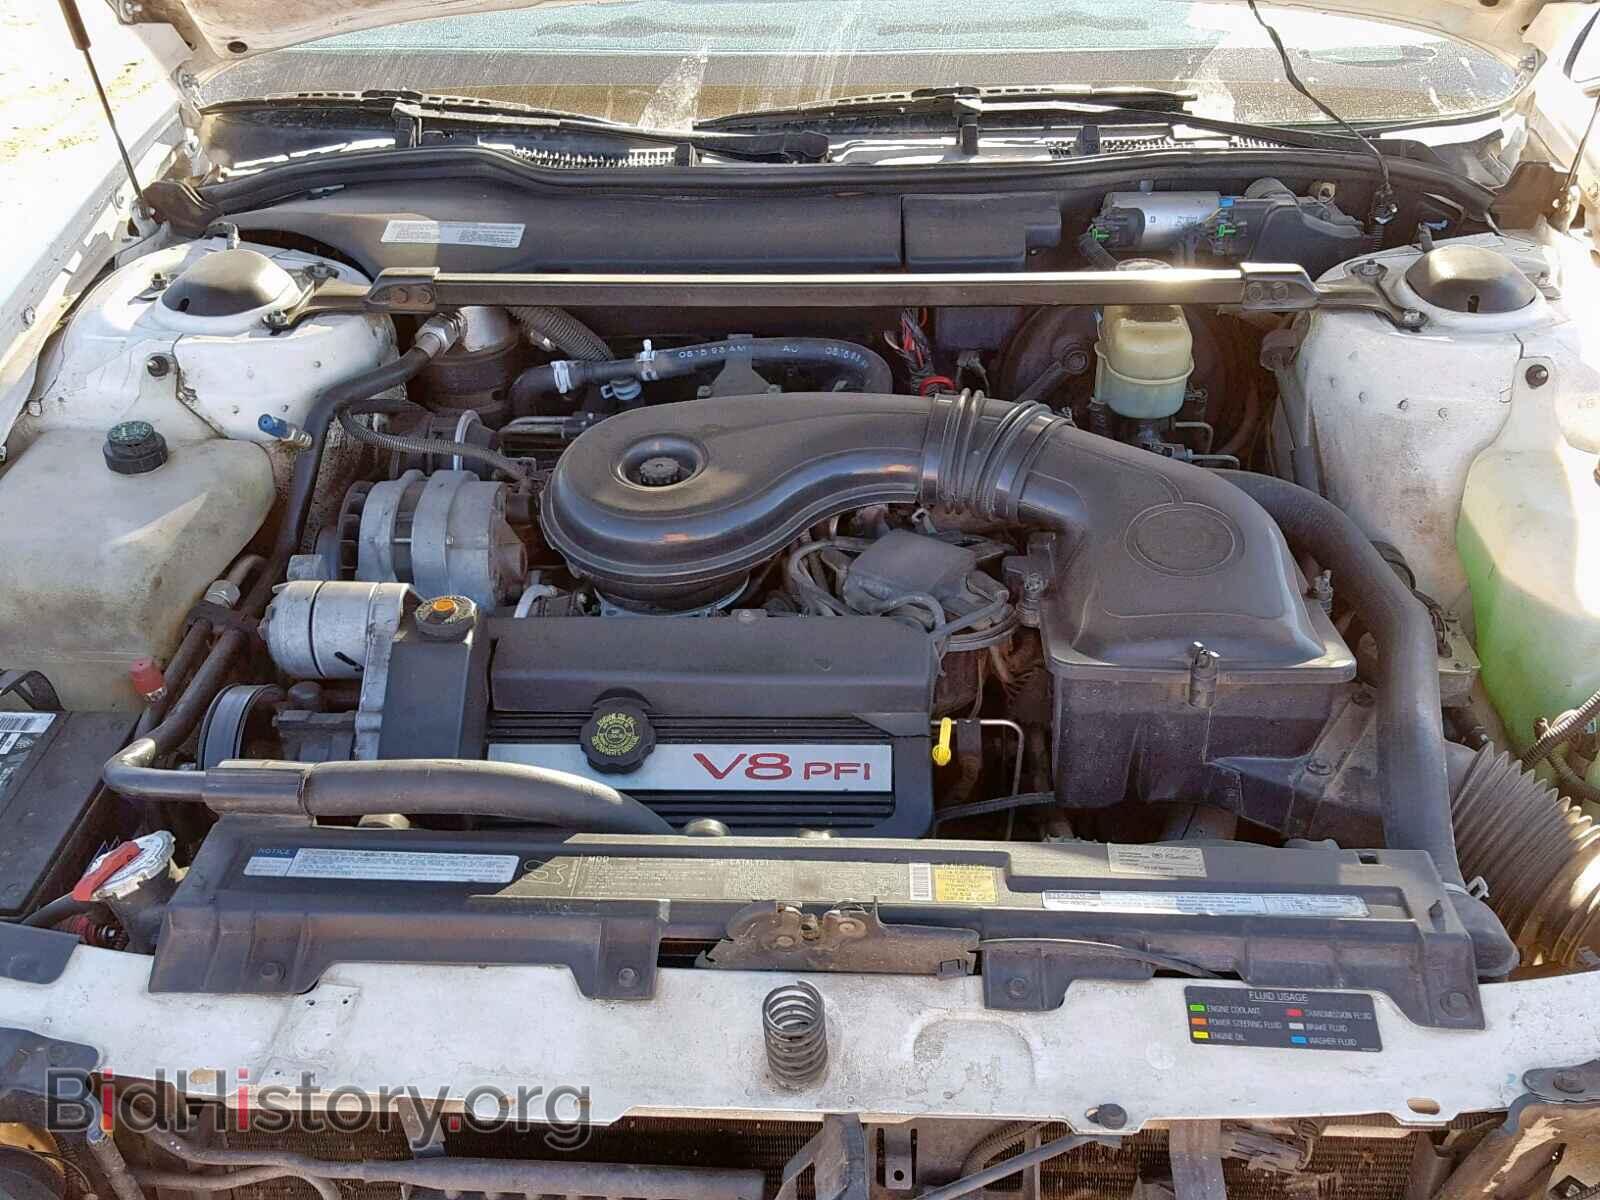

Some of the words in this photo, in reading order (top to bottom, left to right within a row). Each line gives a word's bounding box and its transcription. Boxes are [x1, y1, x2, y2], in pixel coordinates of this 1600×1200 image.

[692, 752, 793, 781] V8
[803, 762, 871, 781] PFI
[1248, 990, 1275, 1001] FLUID
[1277, 991, 1309, 1002] USAGE
[1206, 1004, 1231, 1015] ENGINE
[1231, 1005, 1261, 1016] COOLANT
[1263, 1019, 1282, 1029] FLUID
[1328, 1023, 1348, 1033] FLUID
[1338, 1037, 1357, 1047] FLUID
